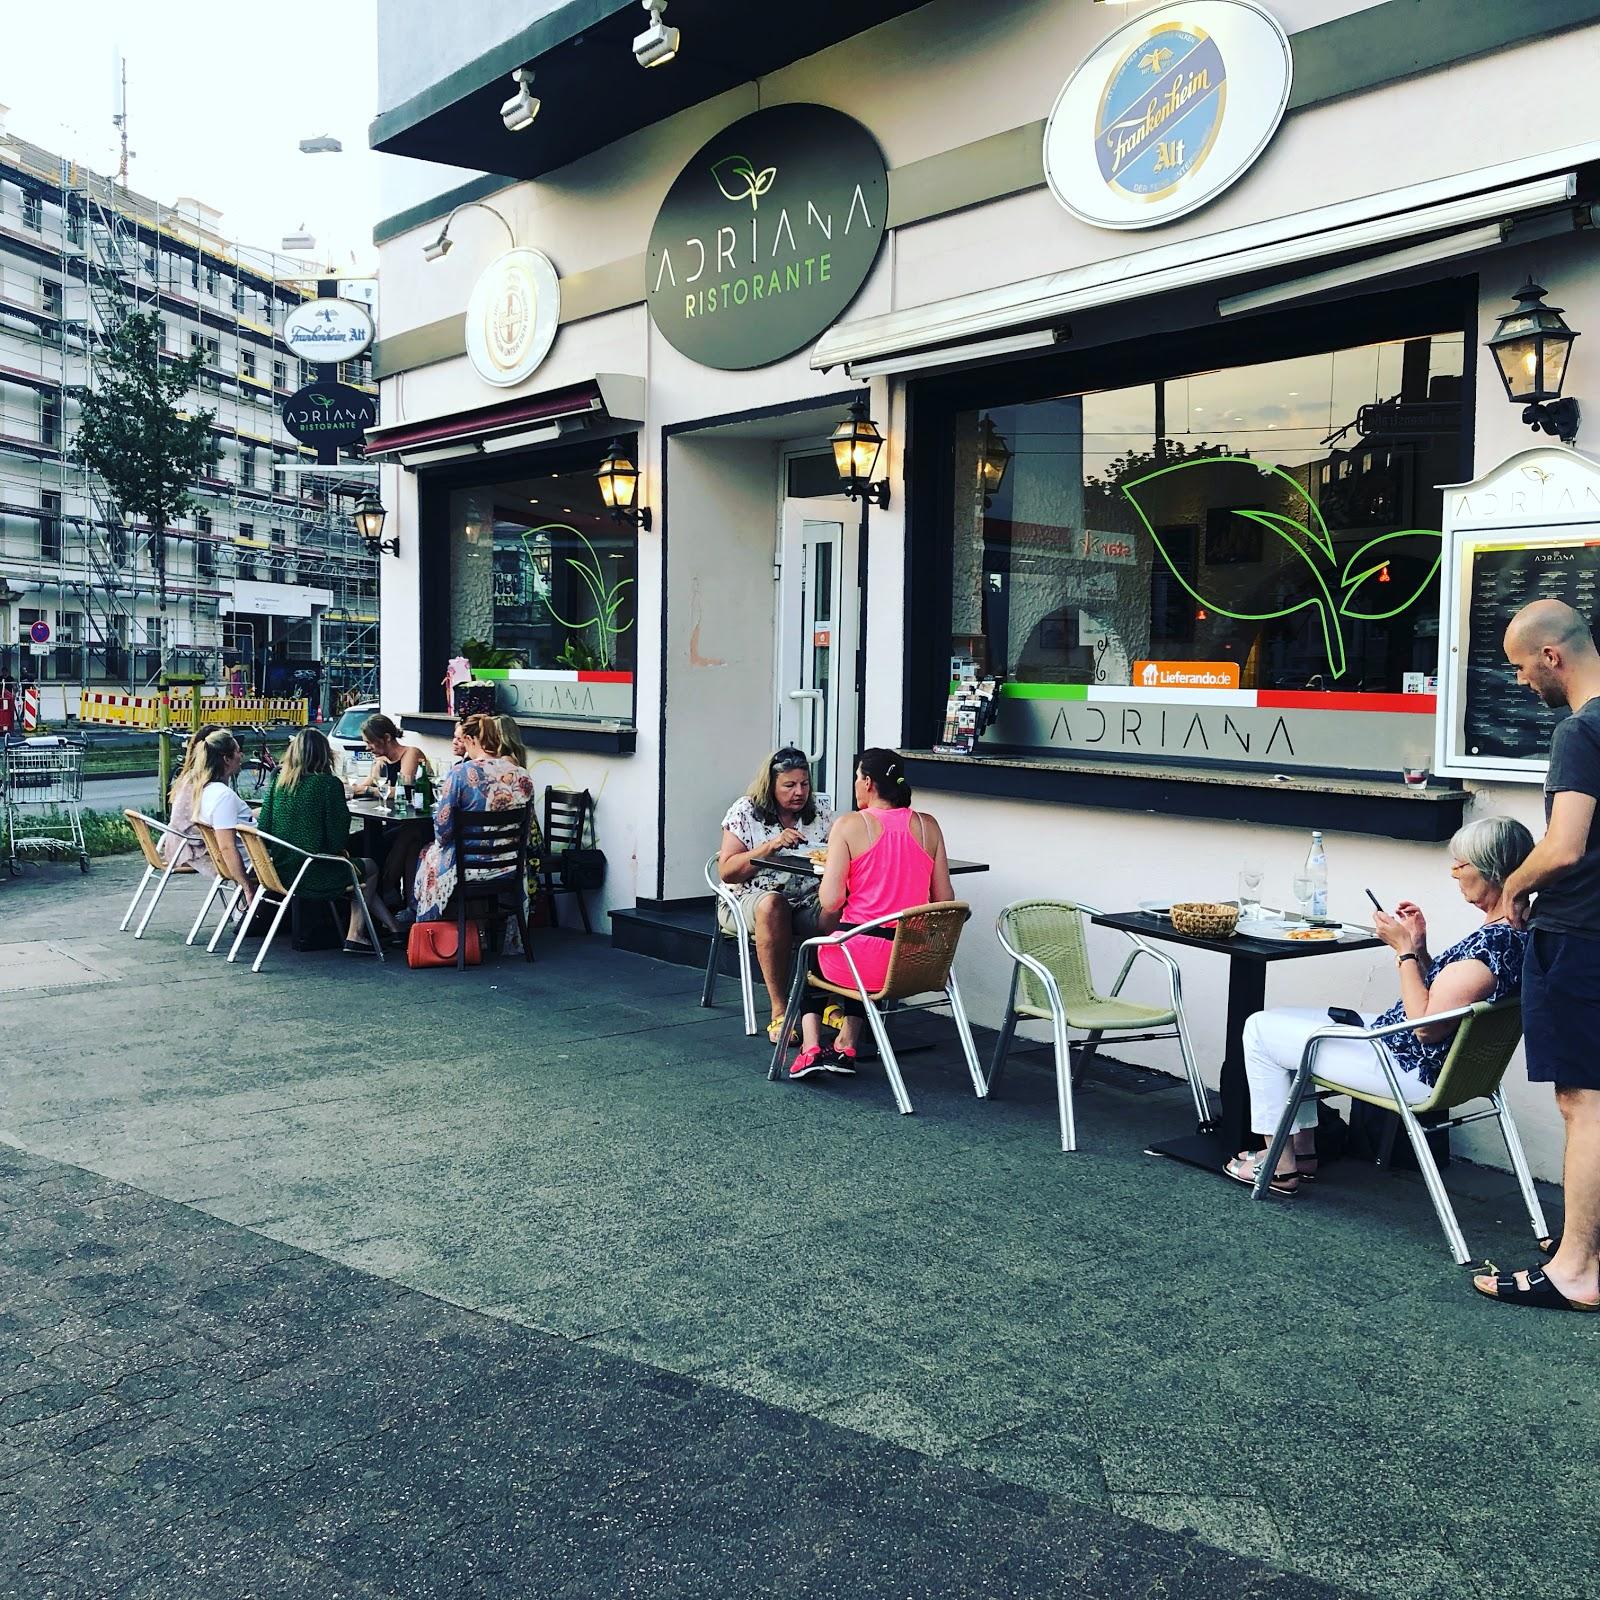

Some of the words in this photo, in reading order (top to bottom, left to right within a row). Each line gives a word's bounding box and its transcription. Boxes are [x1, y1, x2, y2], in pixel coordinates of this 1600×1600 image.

[1106, 68, 1211, 173] Frankenheim
[1153, 139, 1185, 174] Alt
[655, 184, 872, 292] ADRIANA
[685, 253, 832, 319] RISTORANTE
[290, 325, 347, 344] Frankenheim
[348, 327, 366, 342] Alt
[286, 408, 369, 424] ADRIANA
[300, 421, 356, 431] RISTORANTE
[1456, 486, 1600, 518] ADRIAN
[1534, 554, 1575, 562] ADRIANA
[1160, 671, 1231, 685] Lieferando.de
[509, 684, 594, 711] DRIANA
[1050, 707, 1294, 756] ADRIANA
